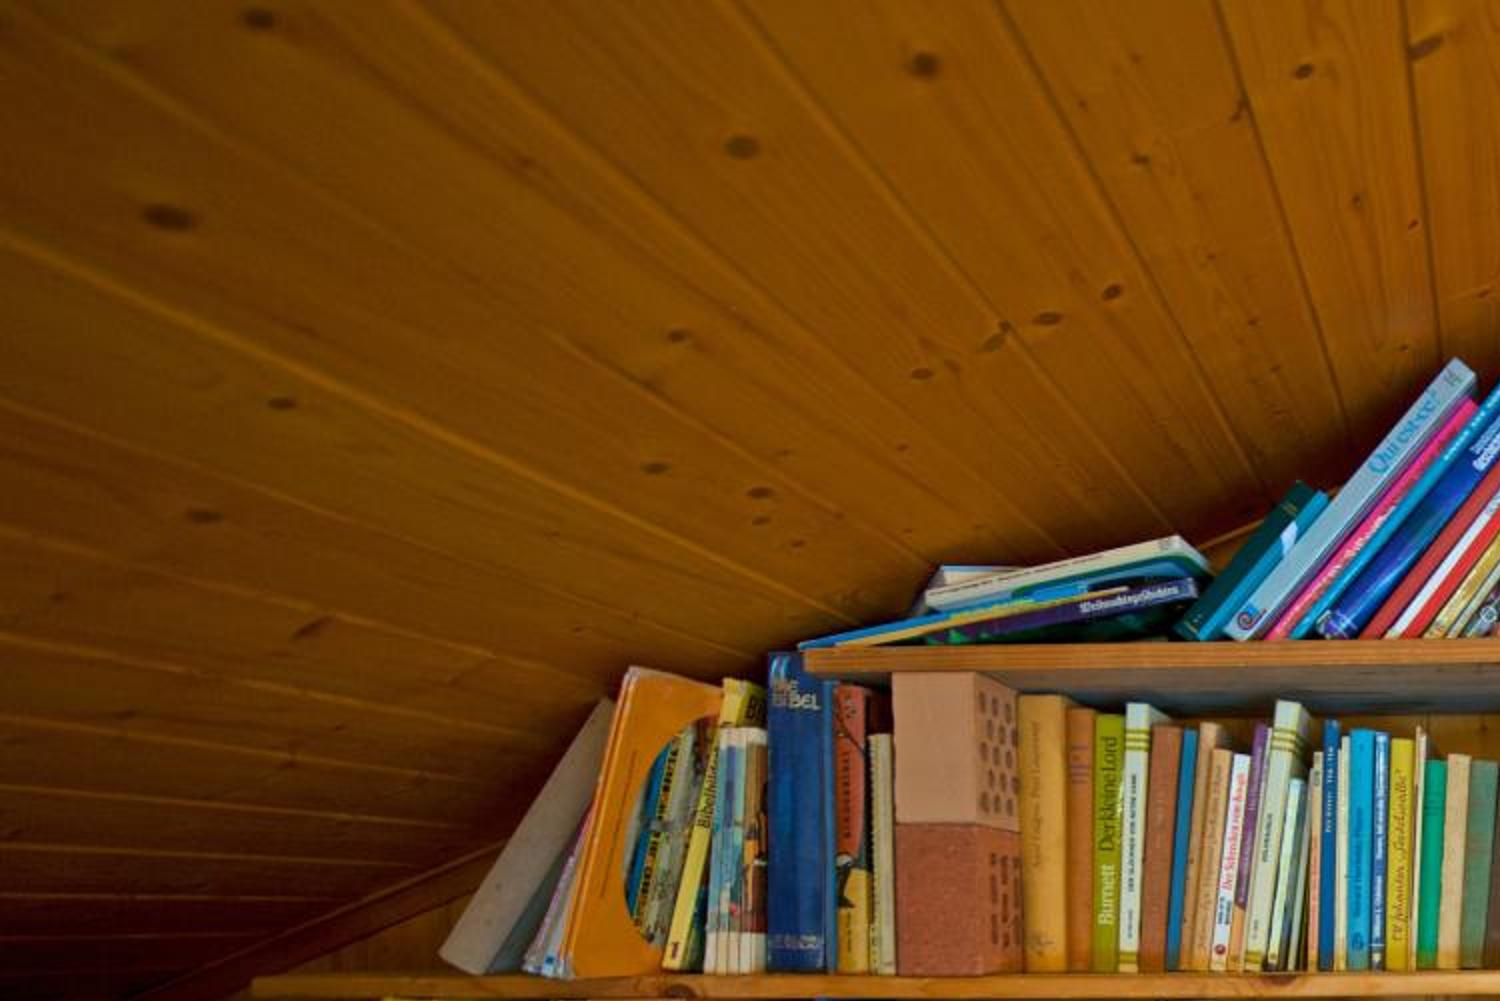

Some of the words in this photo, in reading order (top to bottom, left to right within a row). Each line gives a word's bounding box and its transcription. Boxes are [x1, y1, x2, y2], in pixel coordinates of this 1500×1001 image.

[1367, 441, 1398, 474] Qui
[1101, 735, 1119, 773] Lord
[1100, 821, 1116, 851] Der
[1098, 864, 1117, 926] Burnett
